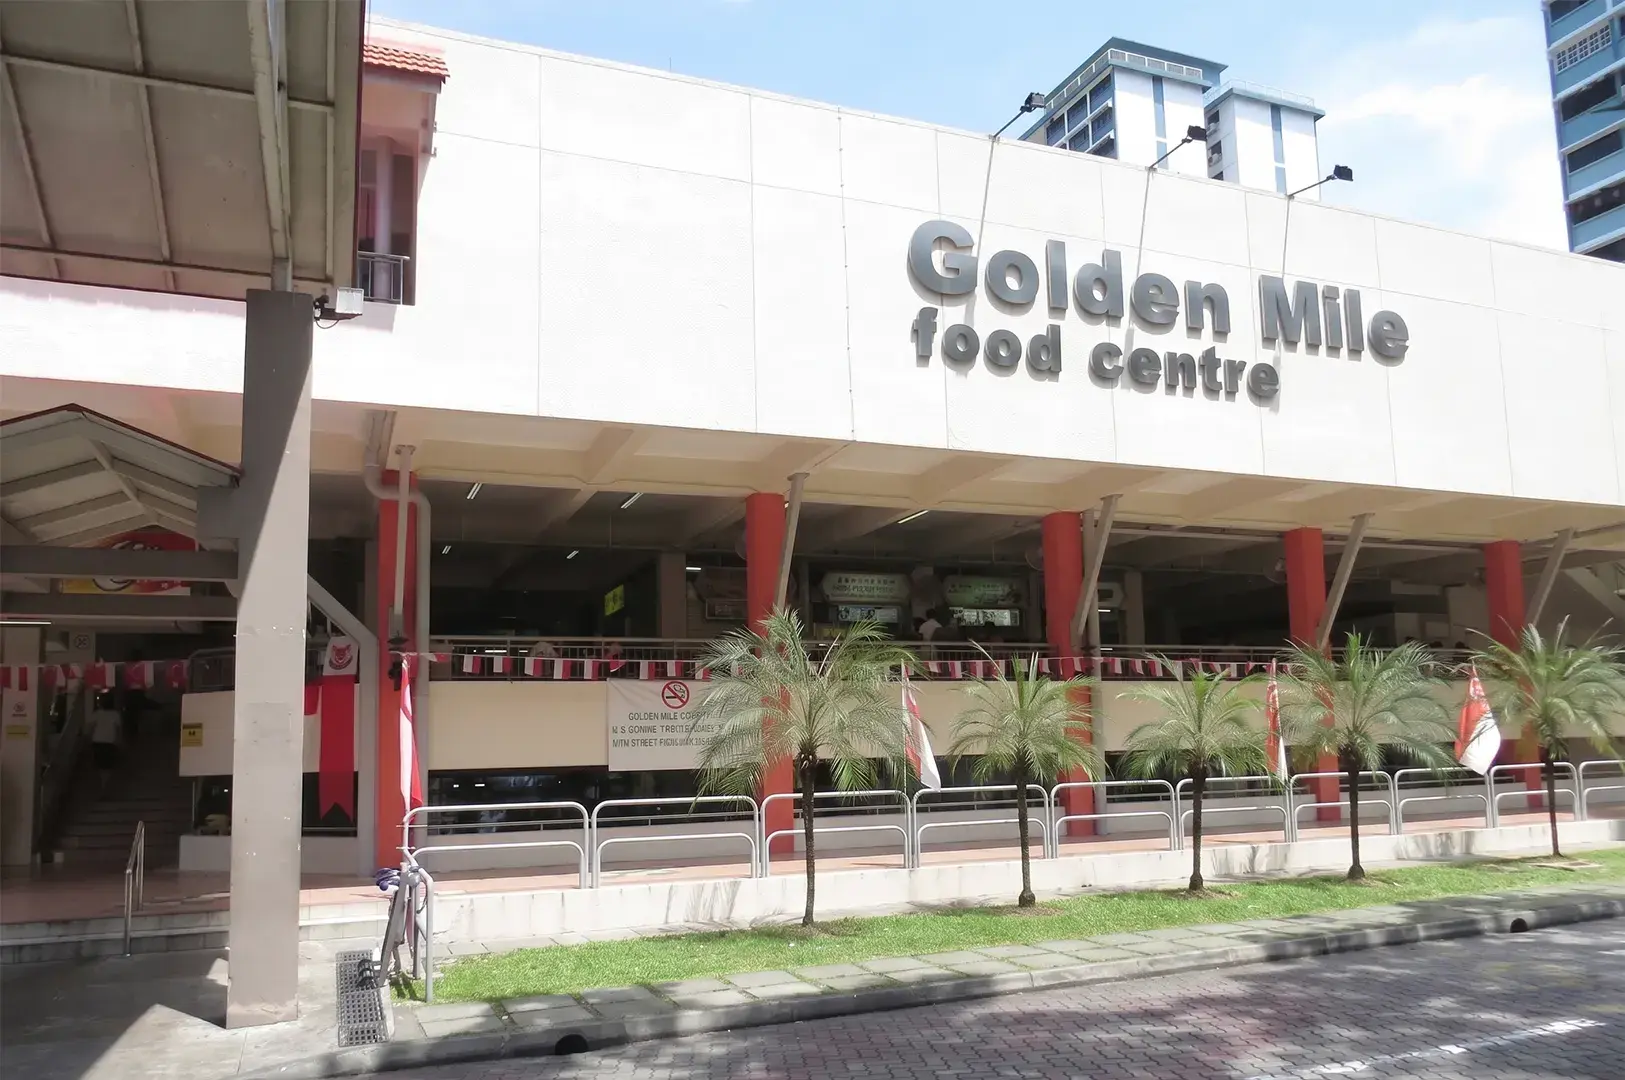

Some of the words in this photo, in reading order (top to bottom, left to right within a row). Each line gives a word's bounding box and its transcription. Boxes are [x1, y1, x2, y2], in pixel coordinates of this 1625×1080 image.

[907, 219, 1231, 335] Golden
[1258, 274, 1410, 363] Mile
[911, 306, 1062, 373] food
[1088, 341, 1280, 398] centre
[628, 712, 659, 721] GOLDEN
[660, 712, 678, 720] MILE
[631, 738, 658, 747] STREET
